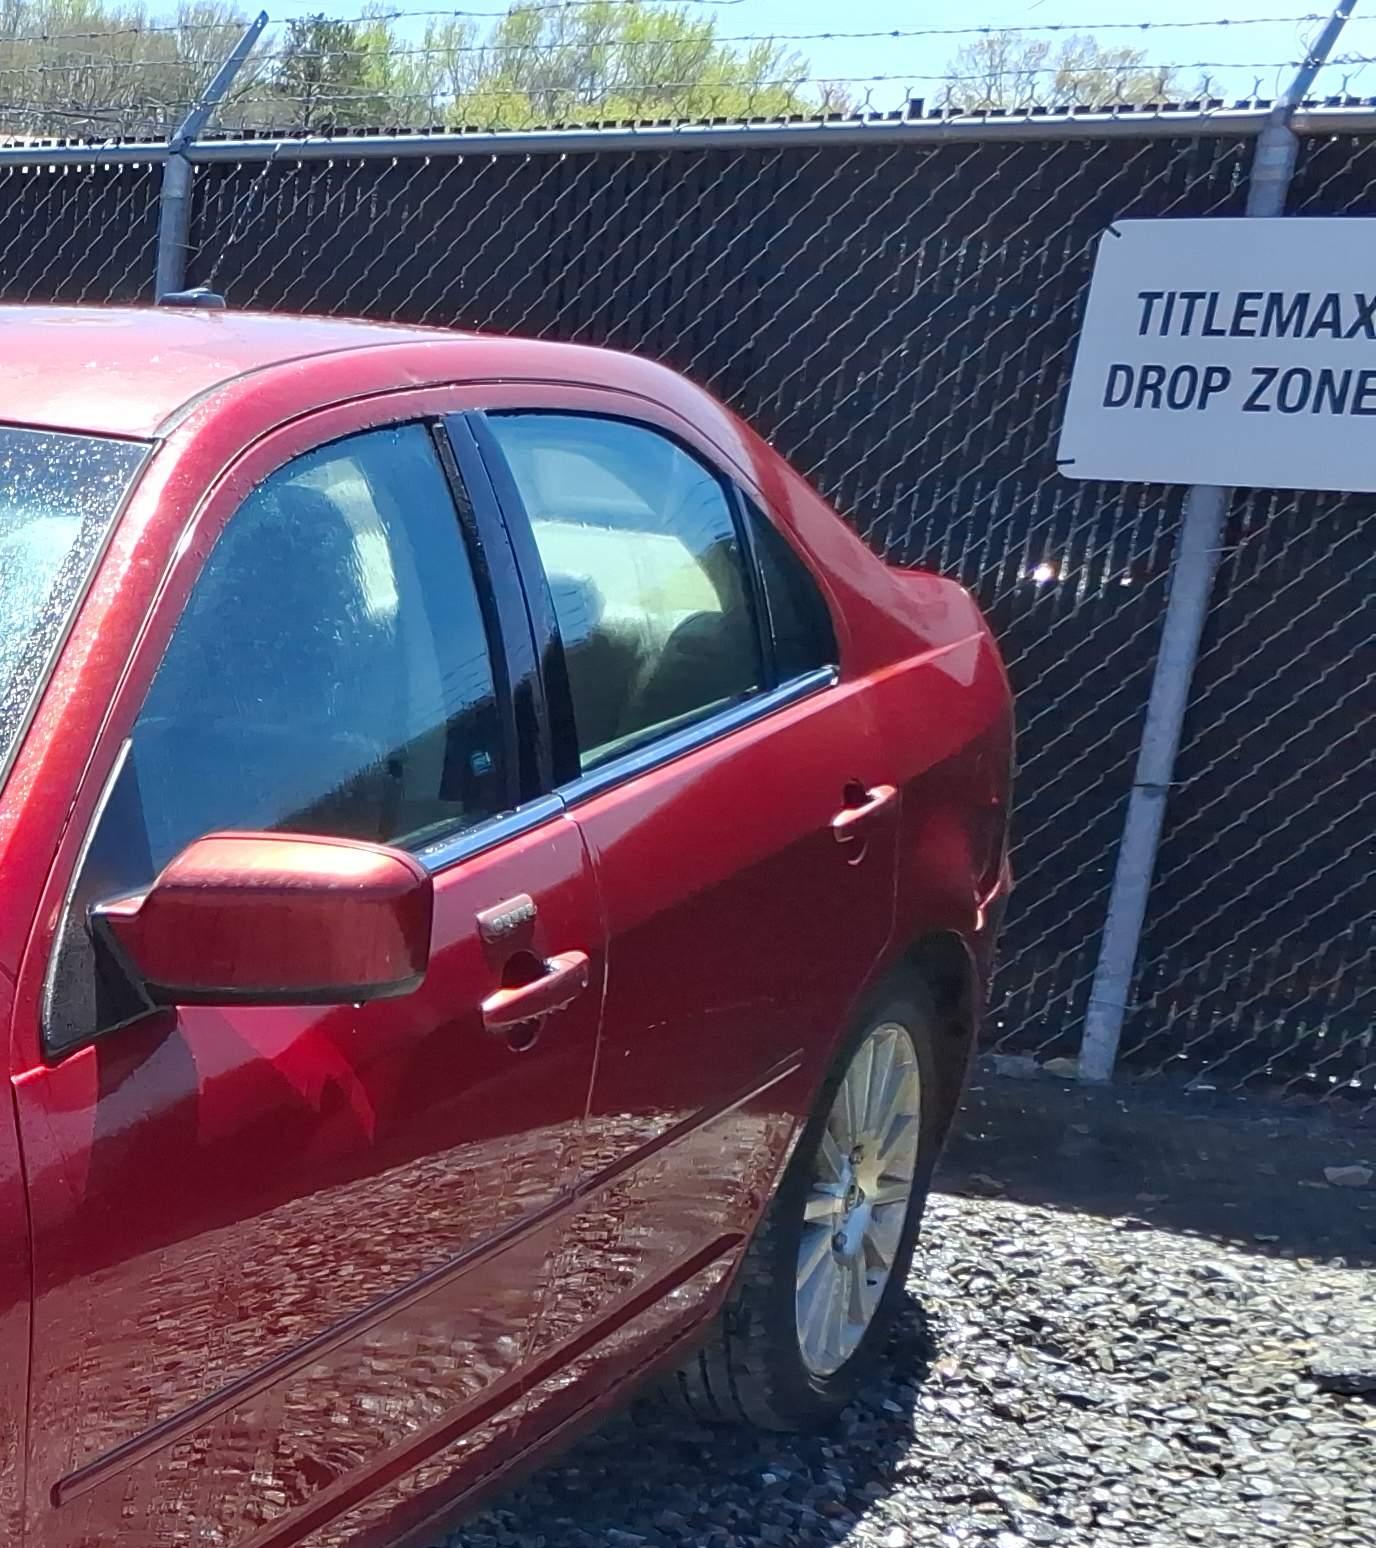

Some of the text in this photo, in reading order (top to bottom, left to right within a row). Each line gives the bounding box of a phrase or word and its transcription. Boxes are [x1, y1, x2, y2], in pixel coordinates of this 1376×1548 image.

[1137, 291, 1376, 340] TITLEMAX
[1102, 364, 1376, 416] DROP ZONE
